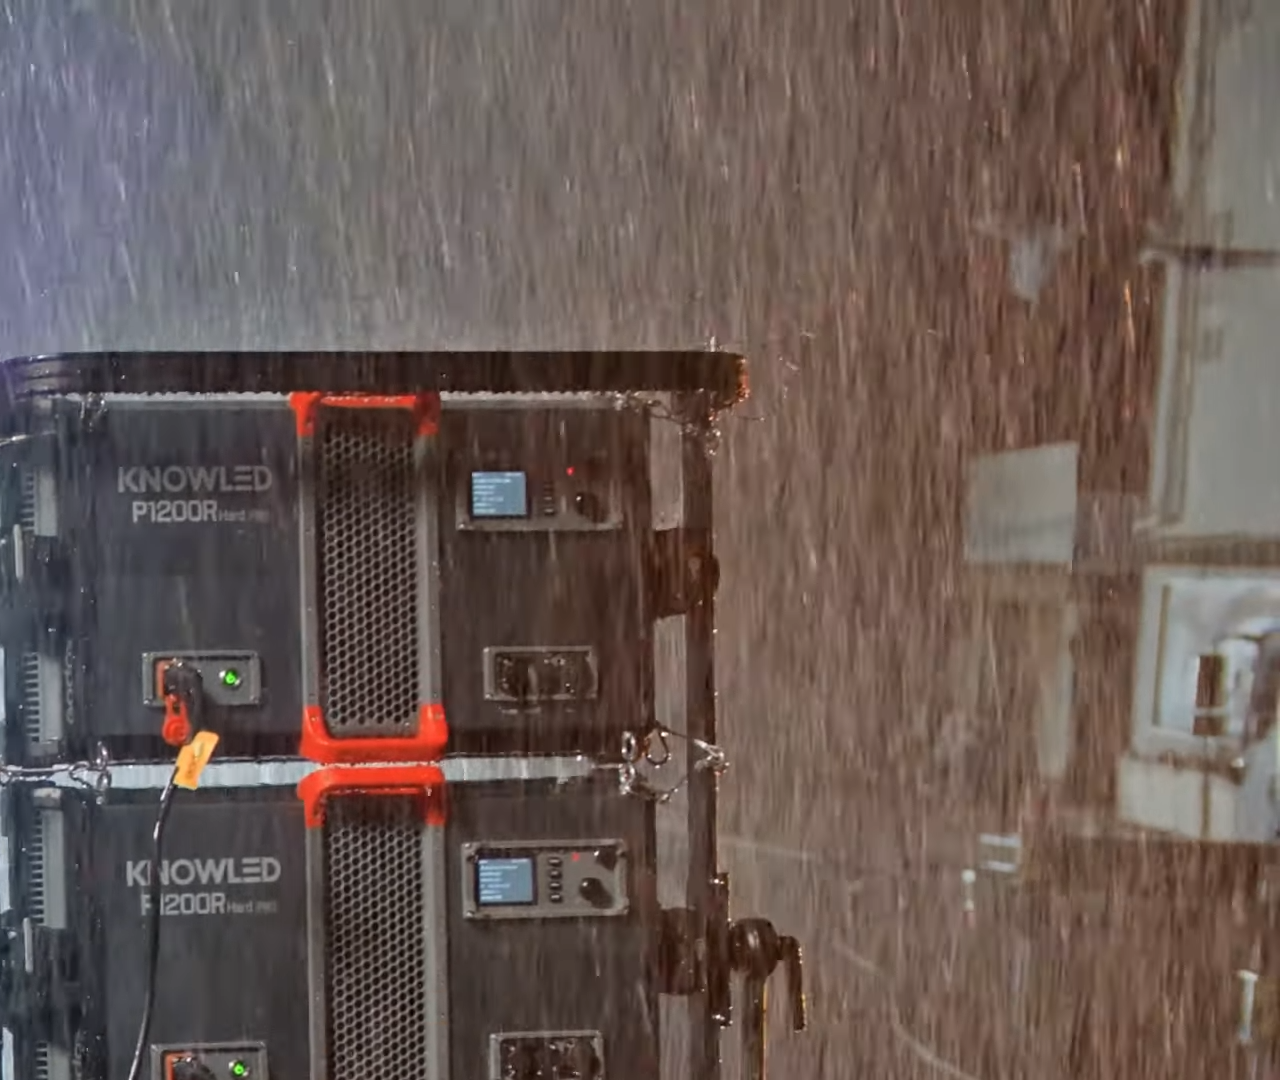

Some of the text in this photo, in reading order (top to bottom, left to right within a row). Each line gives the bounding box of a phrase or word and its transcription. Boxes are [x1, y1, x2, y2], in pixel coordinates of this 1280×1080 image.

[117, 465, 273, 494] KNOWLED
[132, 500, 218, 524] P1200R
[126, 856, 282, 887] KNOWLED
